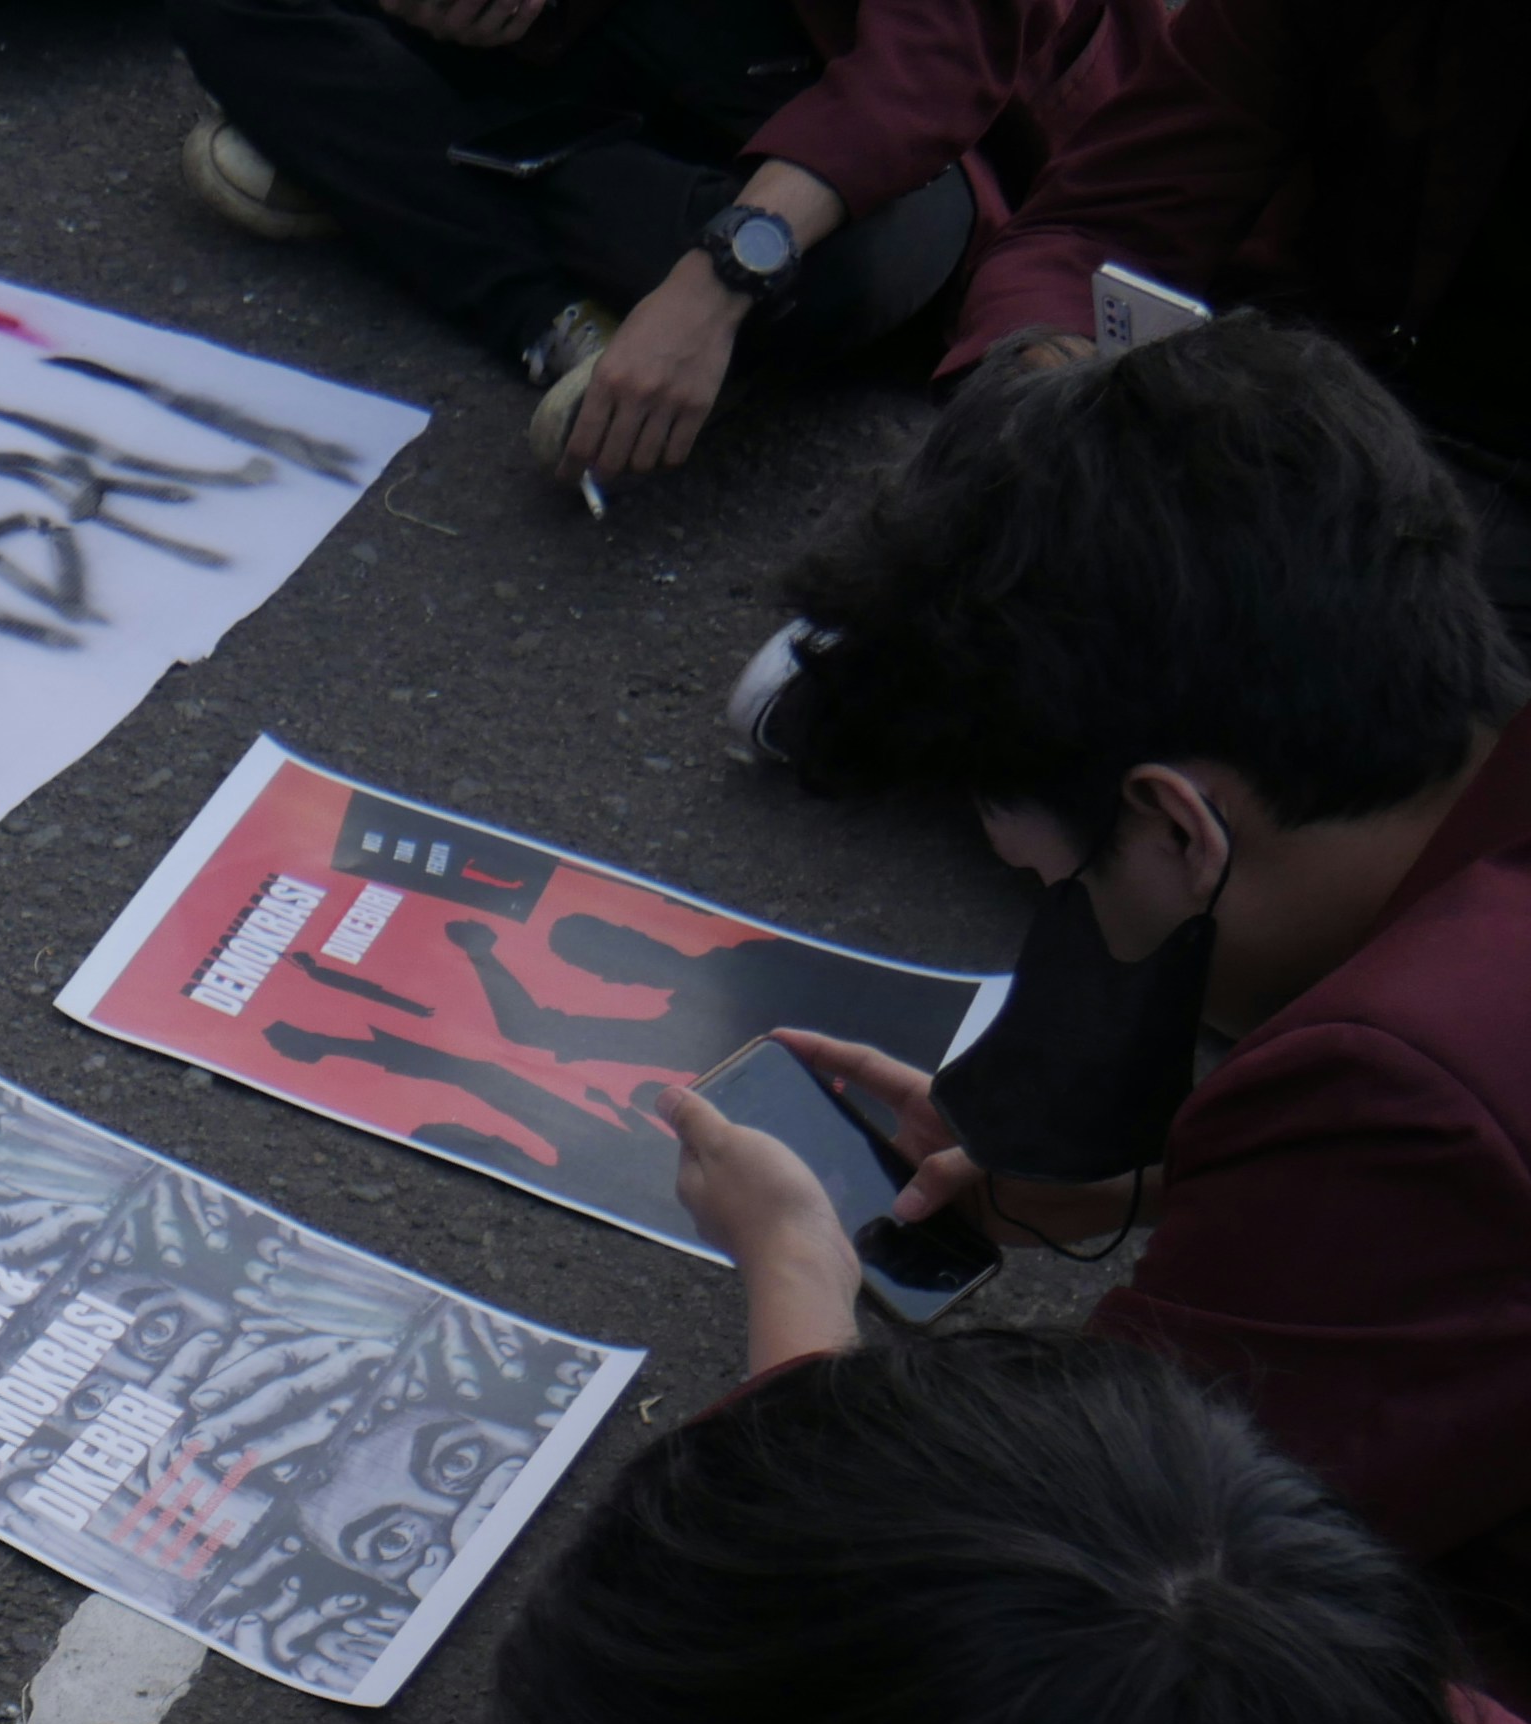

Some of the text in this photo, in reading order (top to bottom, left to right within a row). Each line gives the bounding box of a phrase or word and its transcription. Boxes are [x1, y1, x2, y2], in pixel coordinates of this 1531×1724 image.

[185, 872, 330, 1018] DEMOKRASI
[317, 880, 406, 966] DIKEBIRI
[20, 1380, 186, 1532] DIKEBIRI
